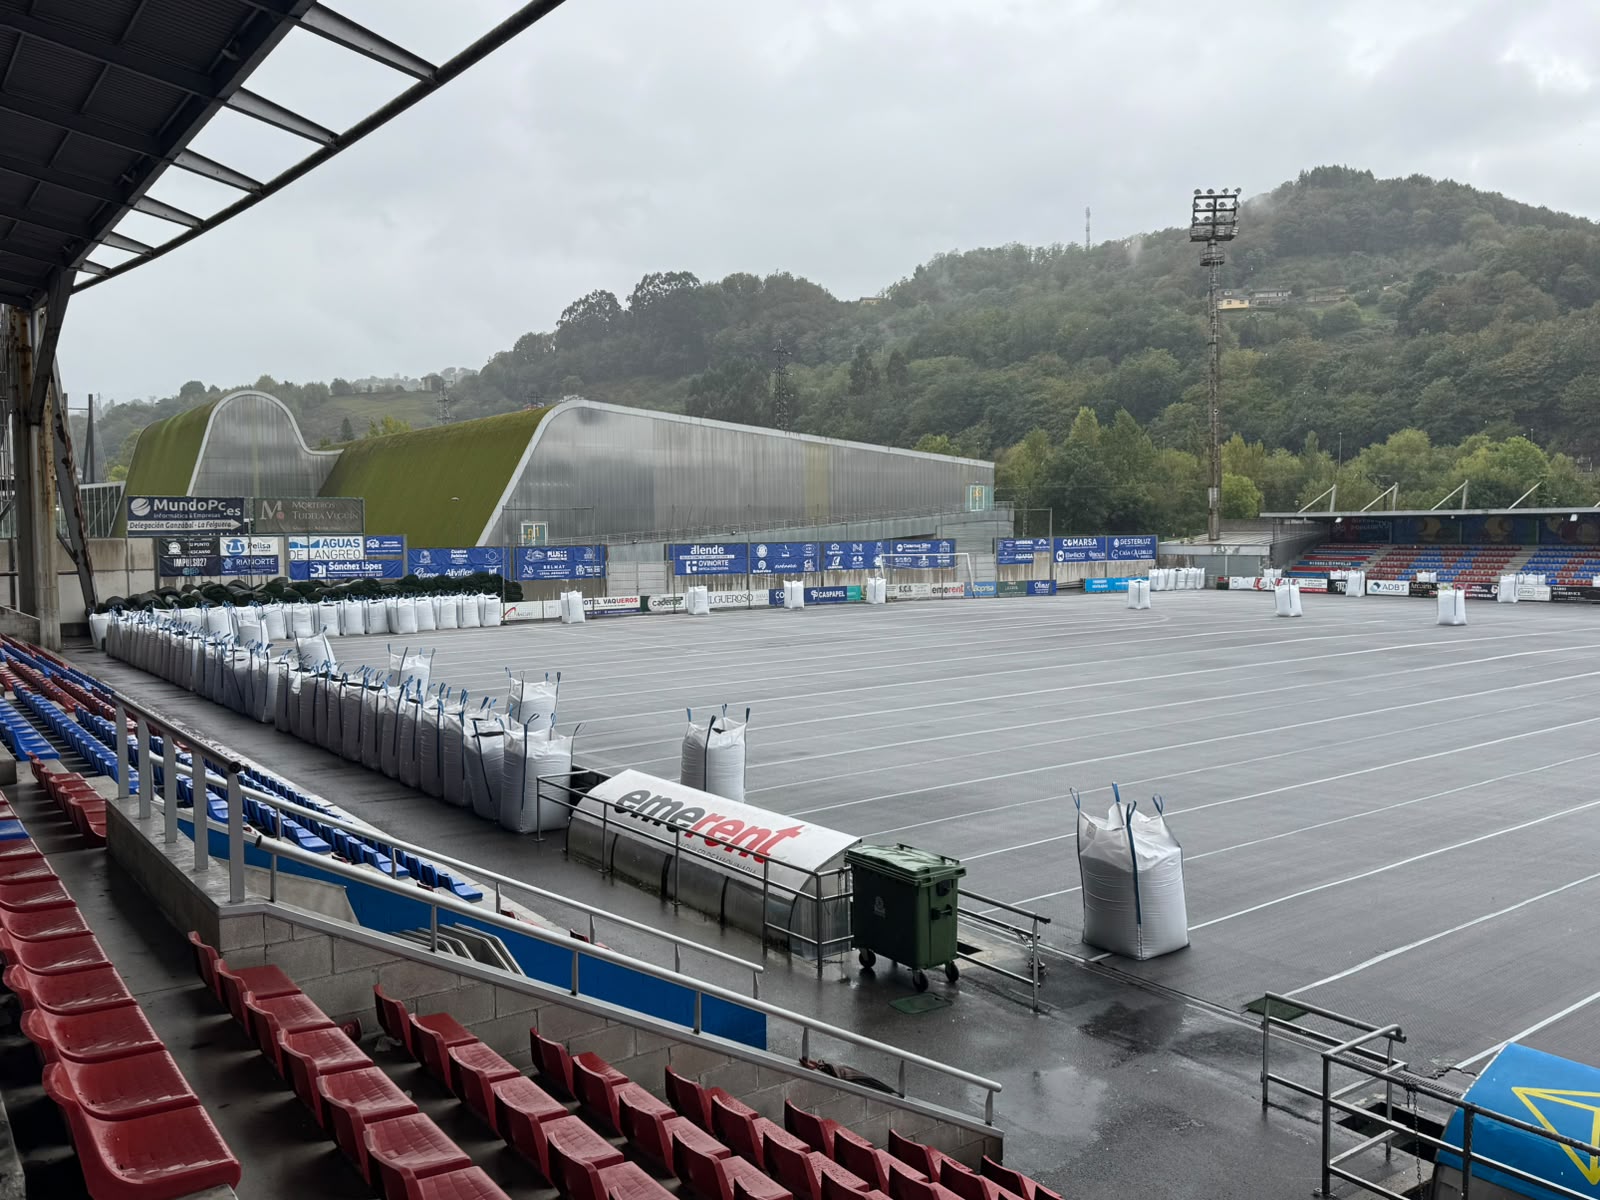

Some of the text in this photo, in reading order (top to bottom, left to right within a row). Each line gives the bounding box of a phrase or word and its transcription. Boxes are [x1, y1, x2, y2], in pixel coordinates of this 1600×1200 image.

[153, 499, 241, 516] MundoPc.es
[129, 521, 164, 530] Delegación
[206, 520, 232, 529] Felguera
[321, 538, 361, 548] AGUAS
[1063, 538, 1097, 546] COMARSA
[289, 550, 361, 560] DE LANGREO
[236, 558, 275, 566] RIANORTE
[328, 561, 383, 572] Sánchez López
[708, 593, 754, 605] LGUEROSO
[819, 590, 845, 598] CASPAPEL
[603, 597, 638, 605] VAQUEROS
[614, 788, 805, 864] emerent
